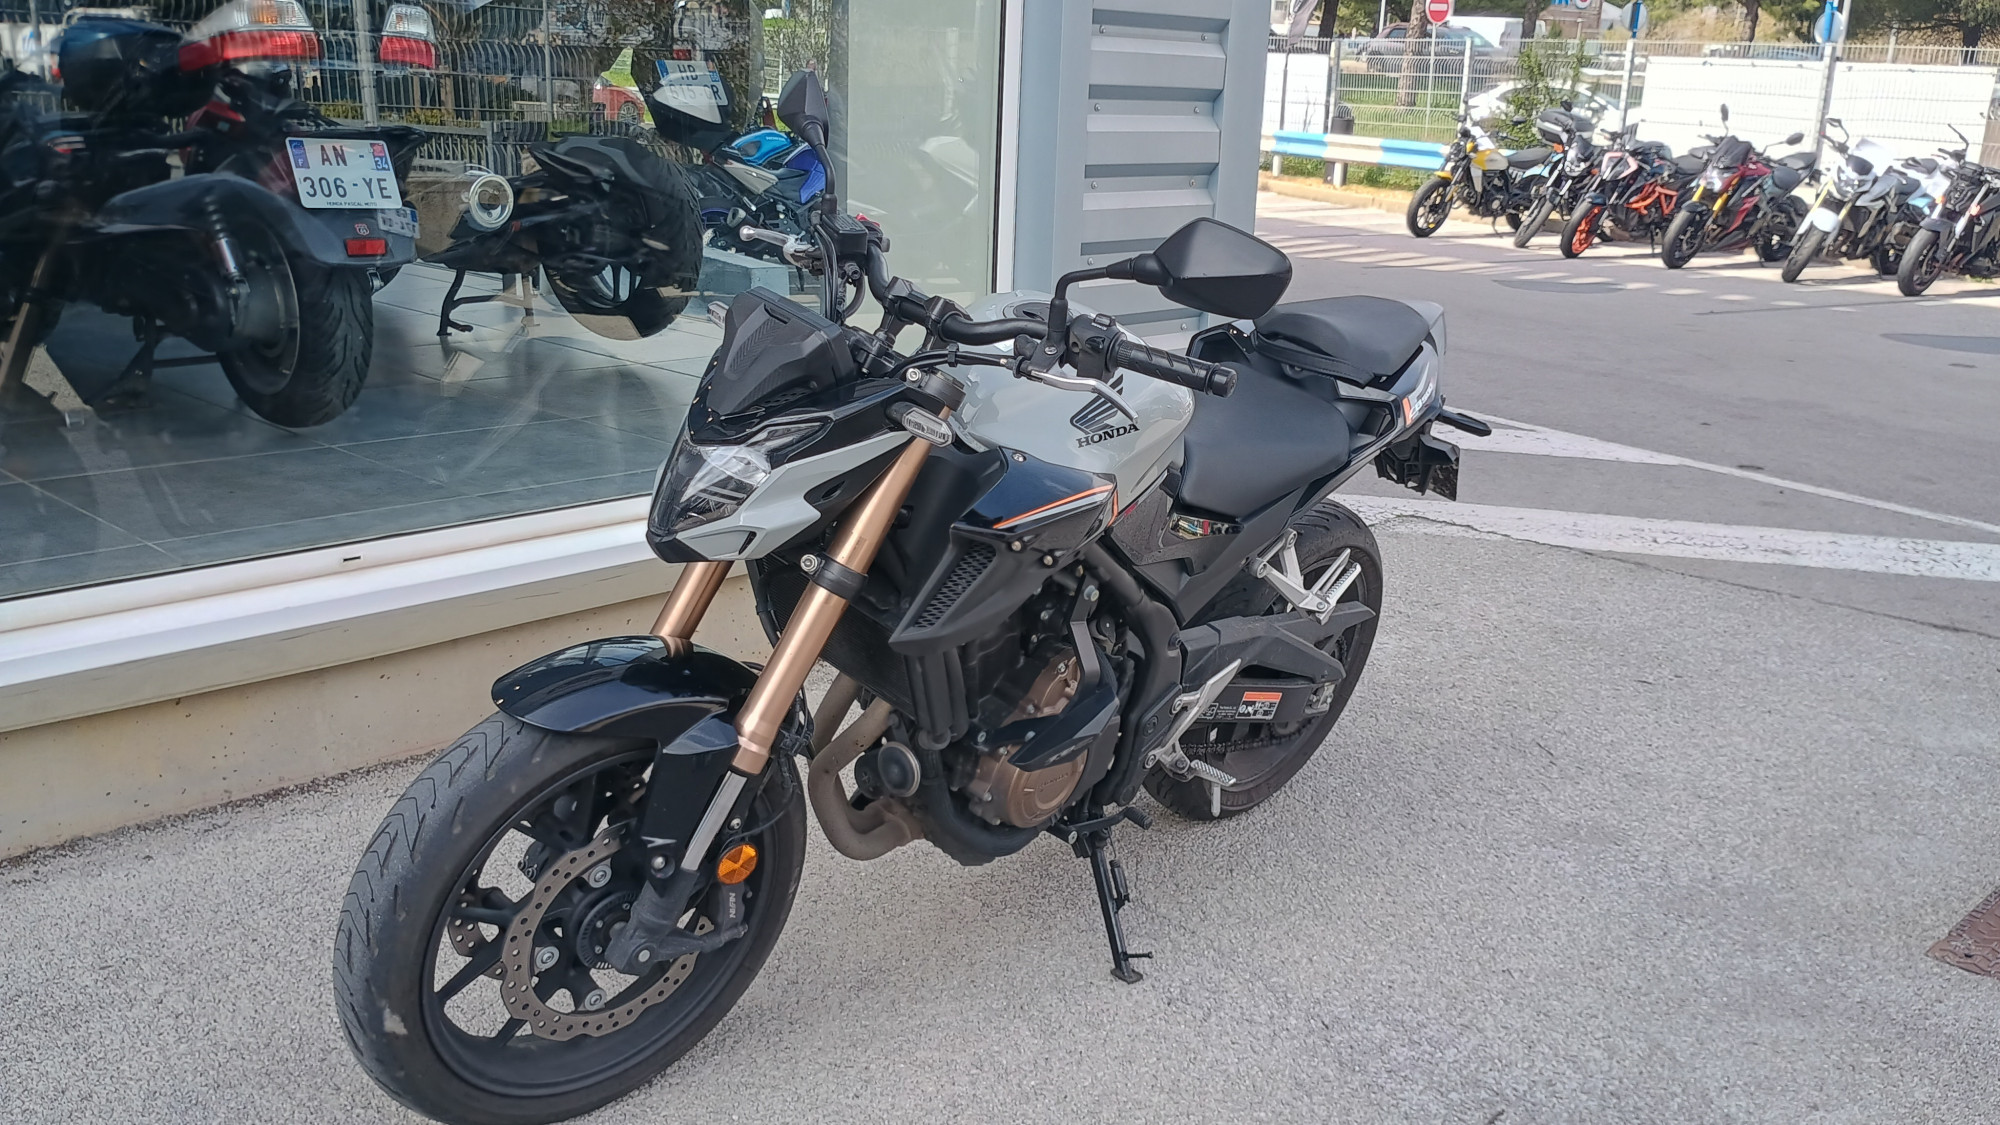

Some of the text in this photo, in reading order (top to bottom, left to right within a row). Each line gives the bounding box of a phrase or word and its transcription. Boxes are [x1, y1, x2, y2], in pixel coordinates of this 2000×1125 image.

[677, 64, 699, 80] HB
[374, 157, 389, 169] 34
[303, 176, 392, 199] 306-YE
[1075, 423, 1140, 448] HONDA
